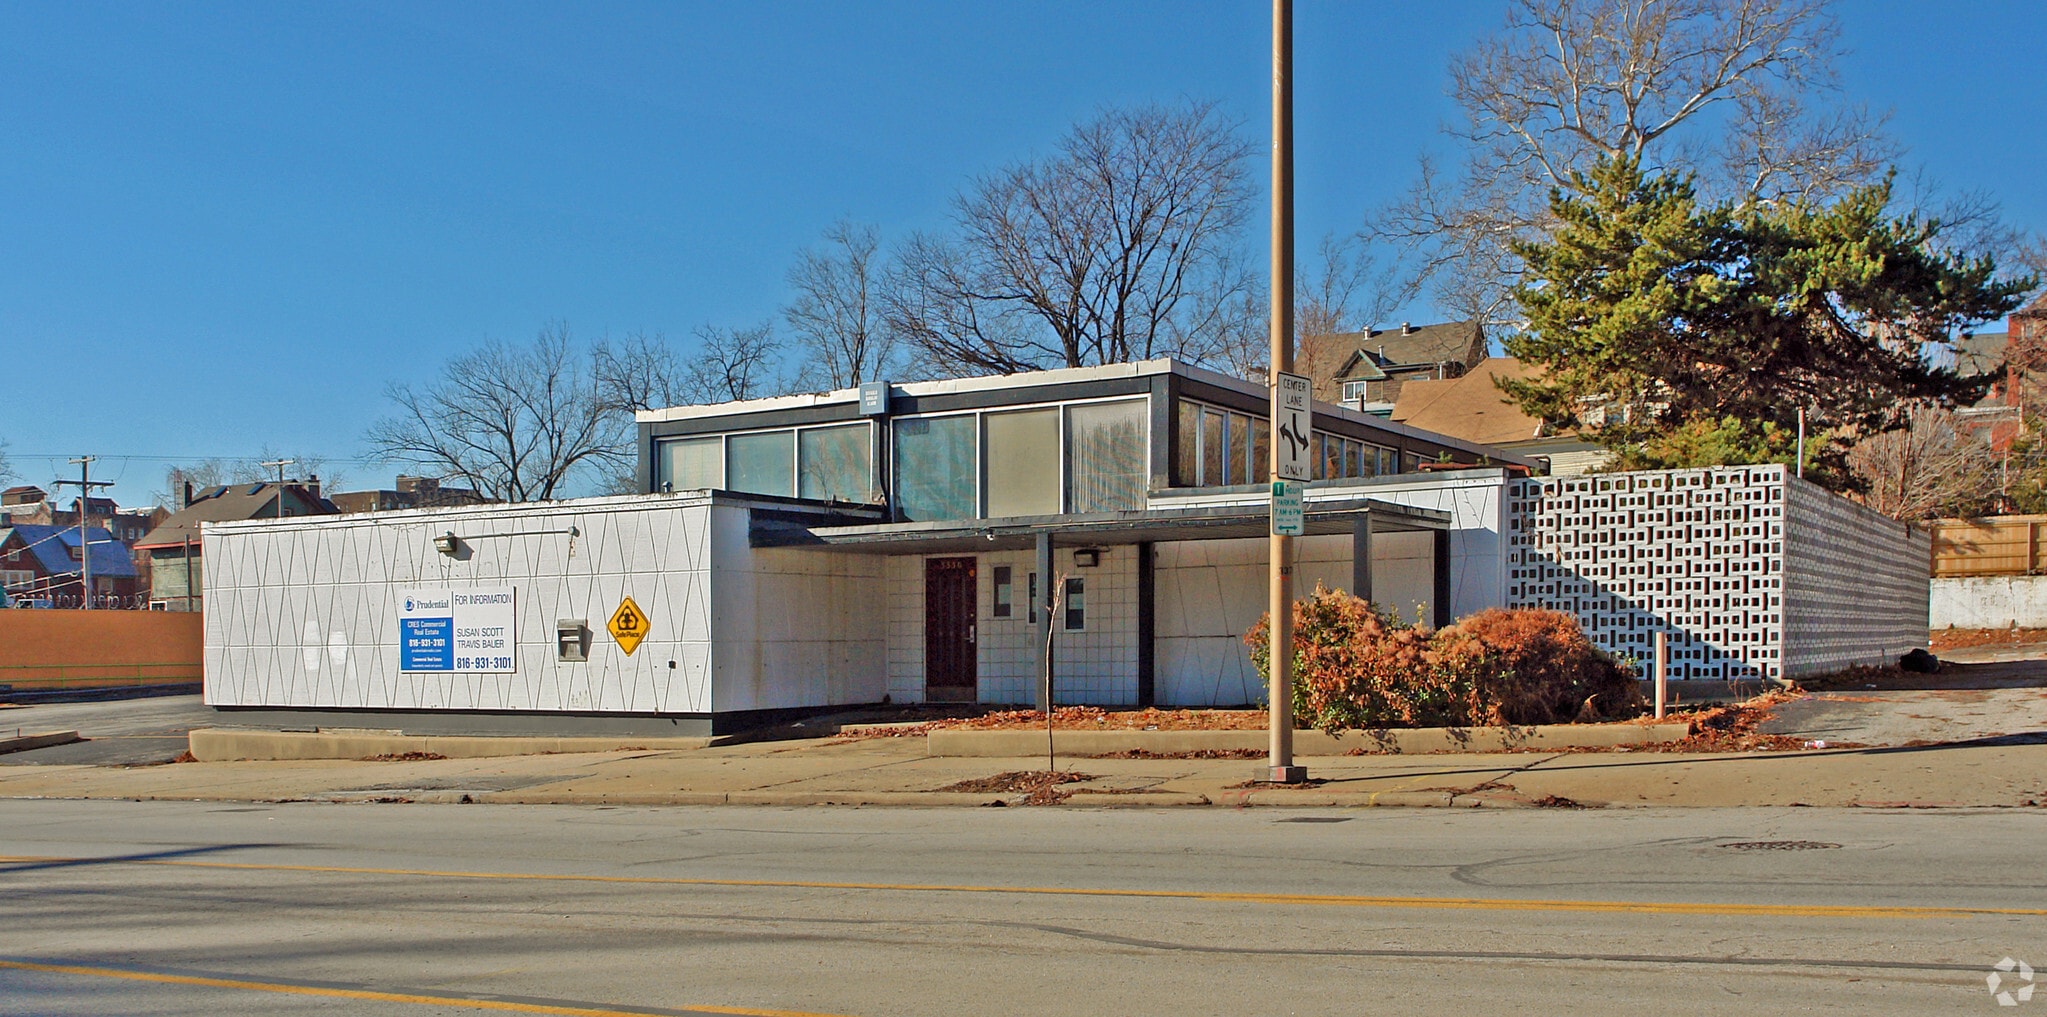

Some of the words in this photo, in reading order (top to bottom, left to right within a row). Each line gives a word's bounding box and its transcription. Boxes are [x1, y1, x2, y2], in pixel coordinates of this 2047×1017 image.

[1283, 378, 1306, 392] CENTER
[1286, 394, 1302, 407] LANE
[1285, 464, 1303, 476] ONLY
[1285, 487, 1300, 495] HOUR
[417, 599, 449, 609] Prudential
[455, 594, 468, 606] FOR
[469, 594, 512, 605] INFORMATION
[421, 620, 446, 628] Commercial
[414, 628, 424, 636] Real
[425, 628, 439, 636] Estate
[456, 628, 480, 637] SUSAN
[481, 627, 505, 637] SCOTT
[408, 638, 446, 647] 816-931-3101
[457, 640, 480, 649] TRAVIS
[482, 639, 505, 649] BAUER
[456, 657, 512, 669] 816-931-3101
